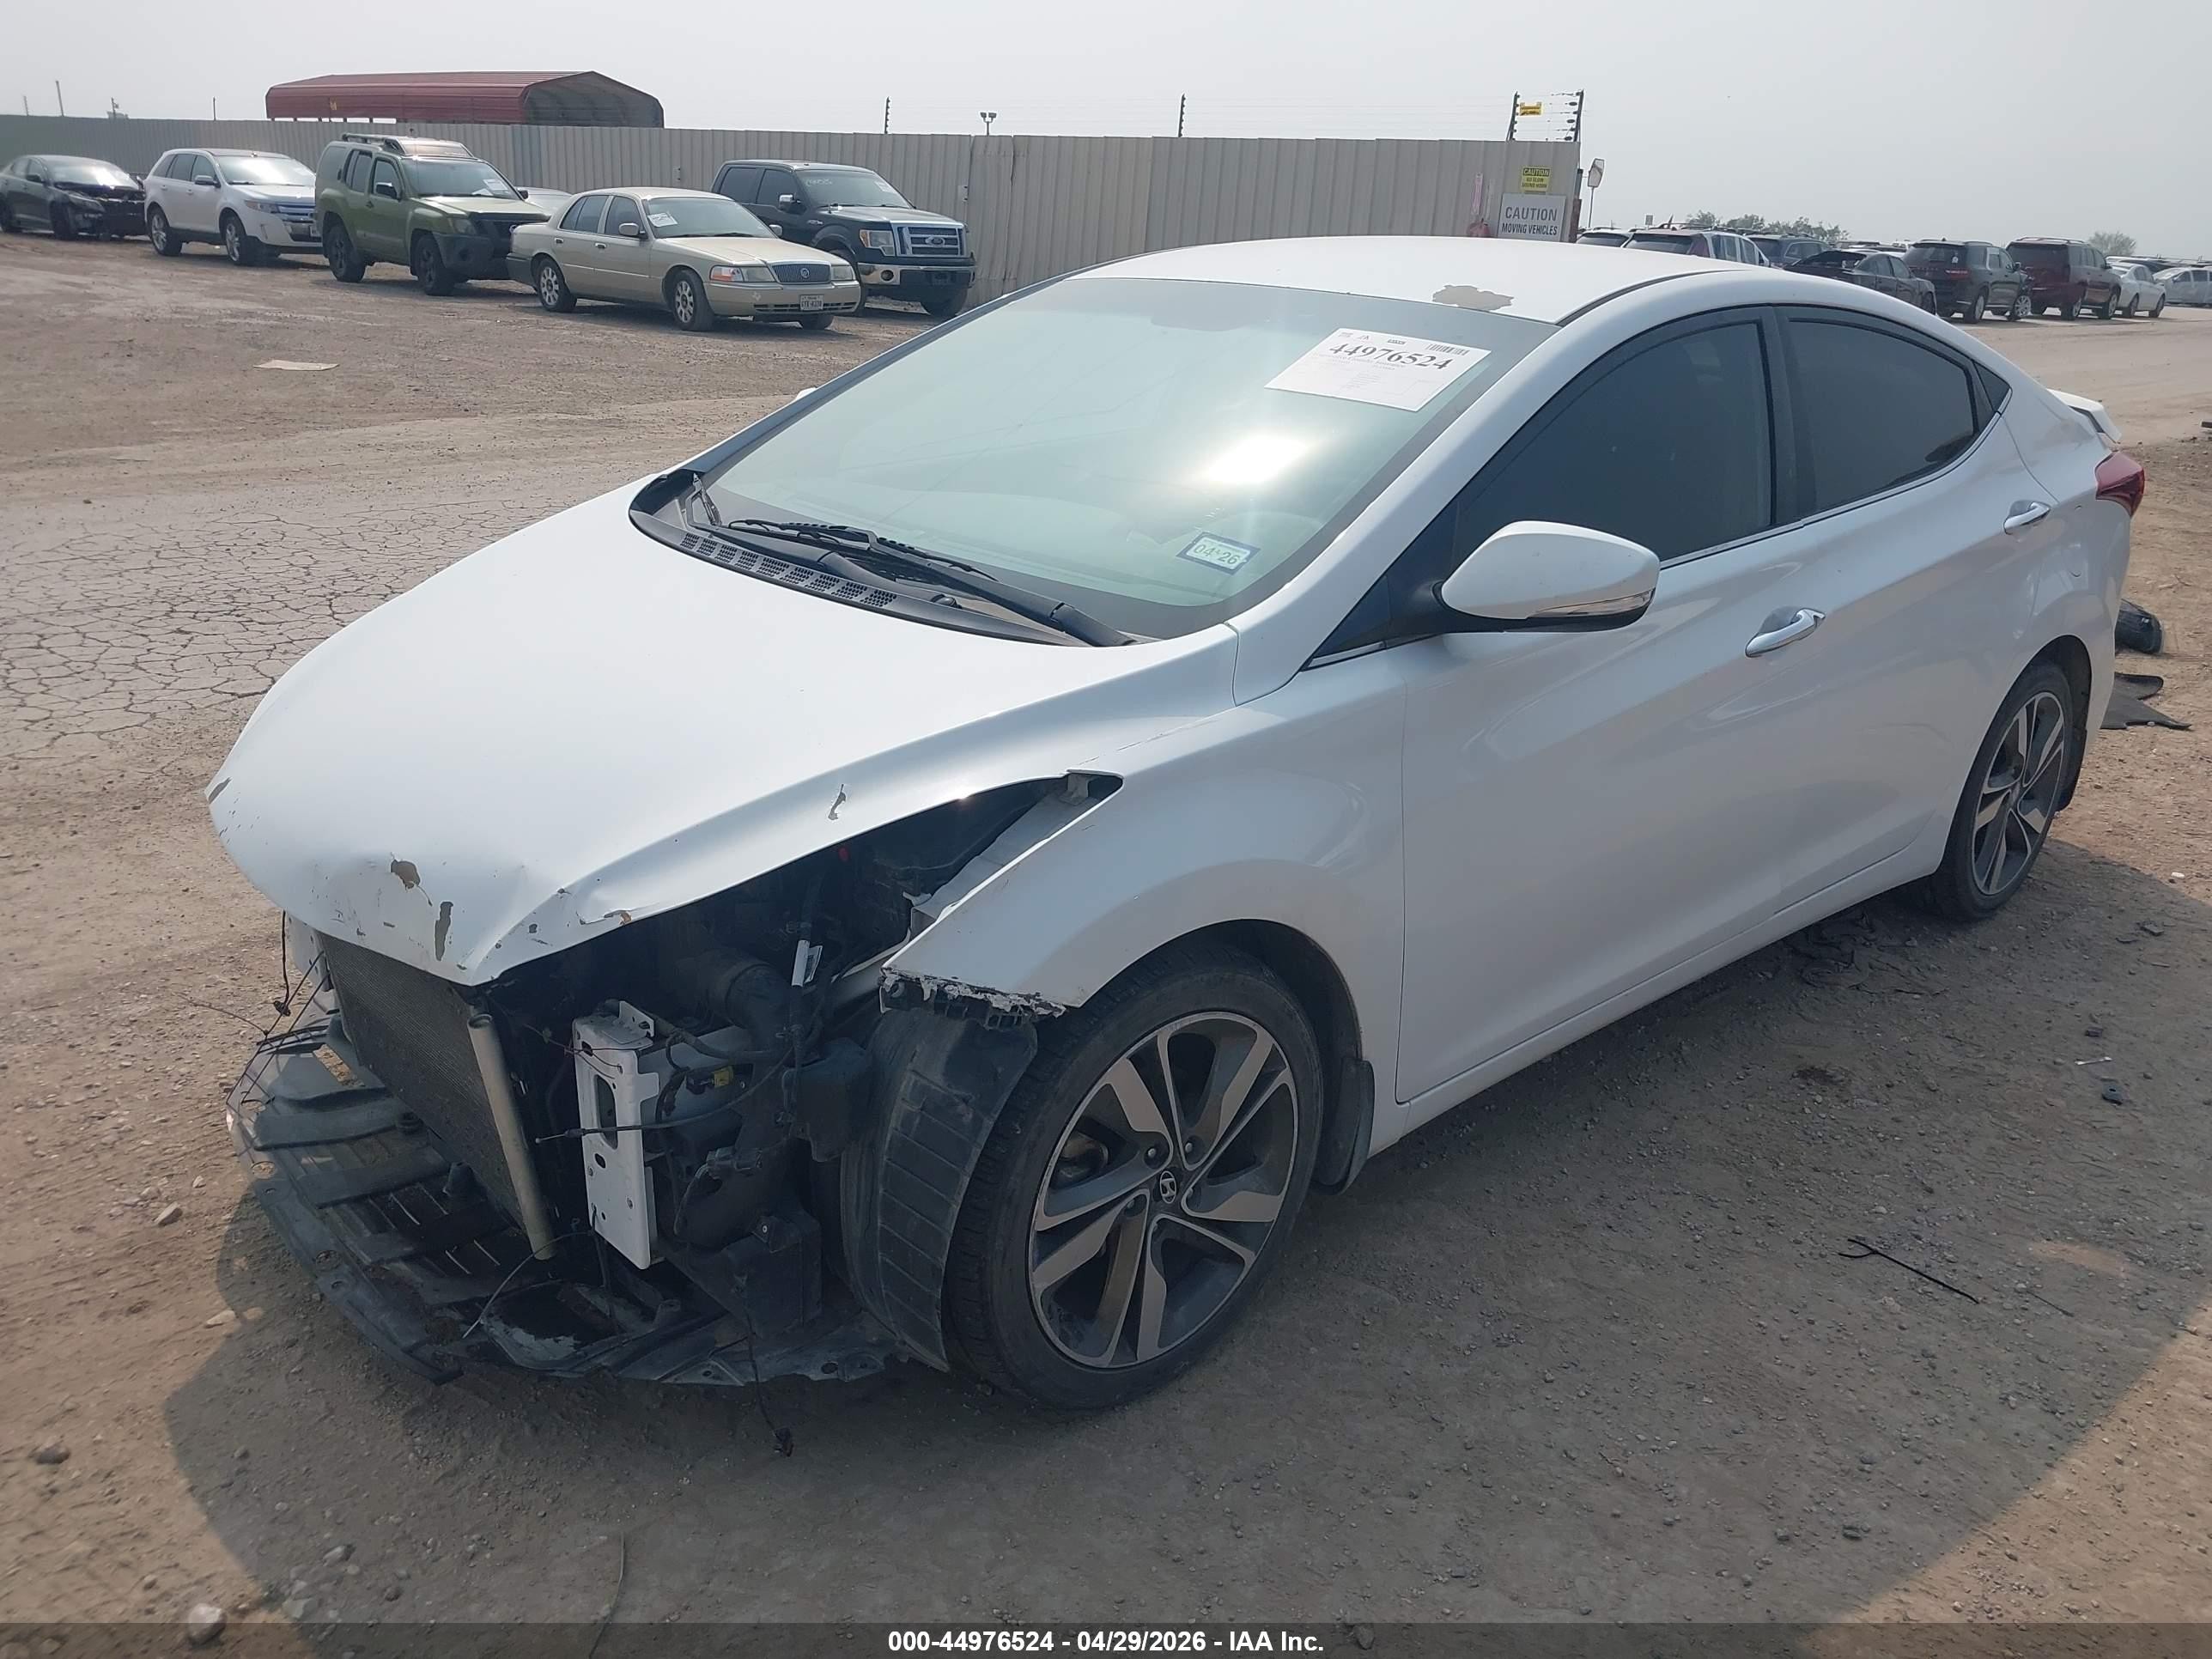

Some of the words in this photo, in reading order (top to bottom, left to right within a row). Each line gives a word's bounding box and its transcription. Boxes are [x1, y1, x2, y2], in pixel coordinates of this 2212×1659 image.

[1523, 168, 1549, 177] CAUTION
[1505, 206, 1558, 222] CAUTION
[1501, 222, 1528, 234] MOVING
[1528, 224, 1558, 236] VEHICLES
[1328, 343, 1454, 370] 44976524
